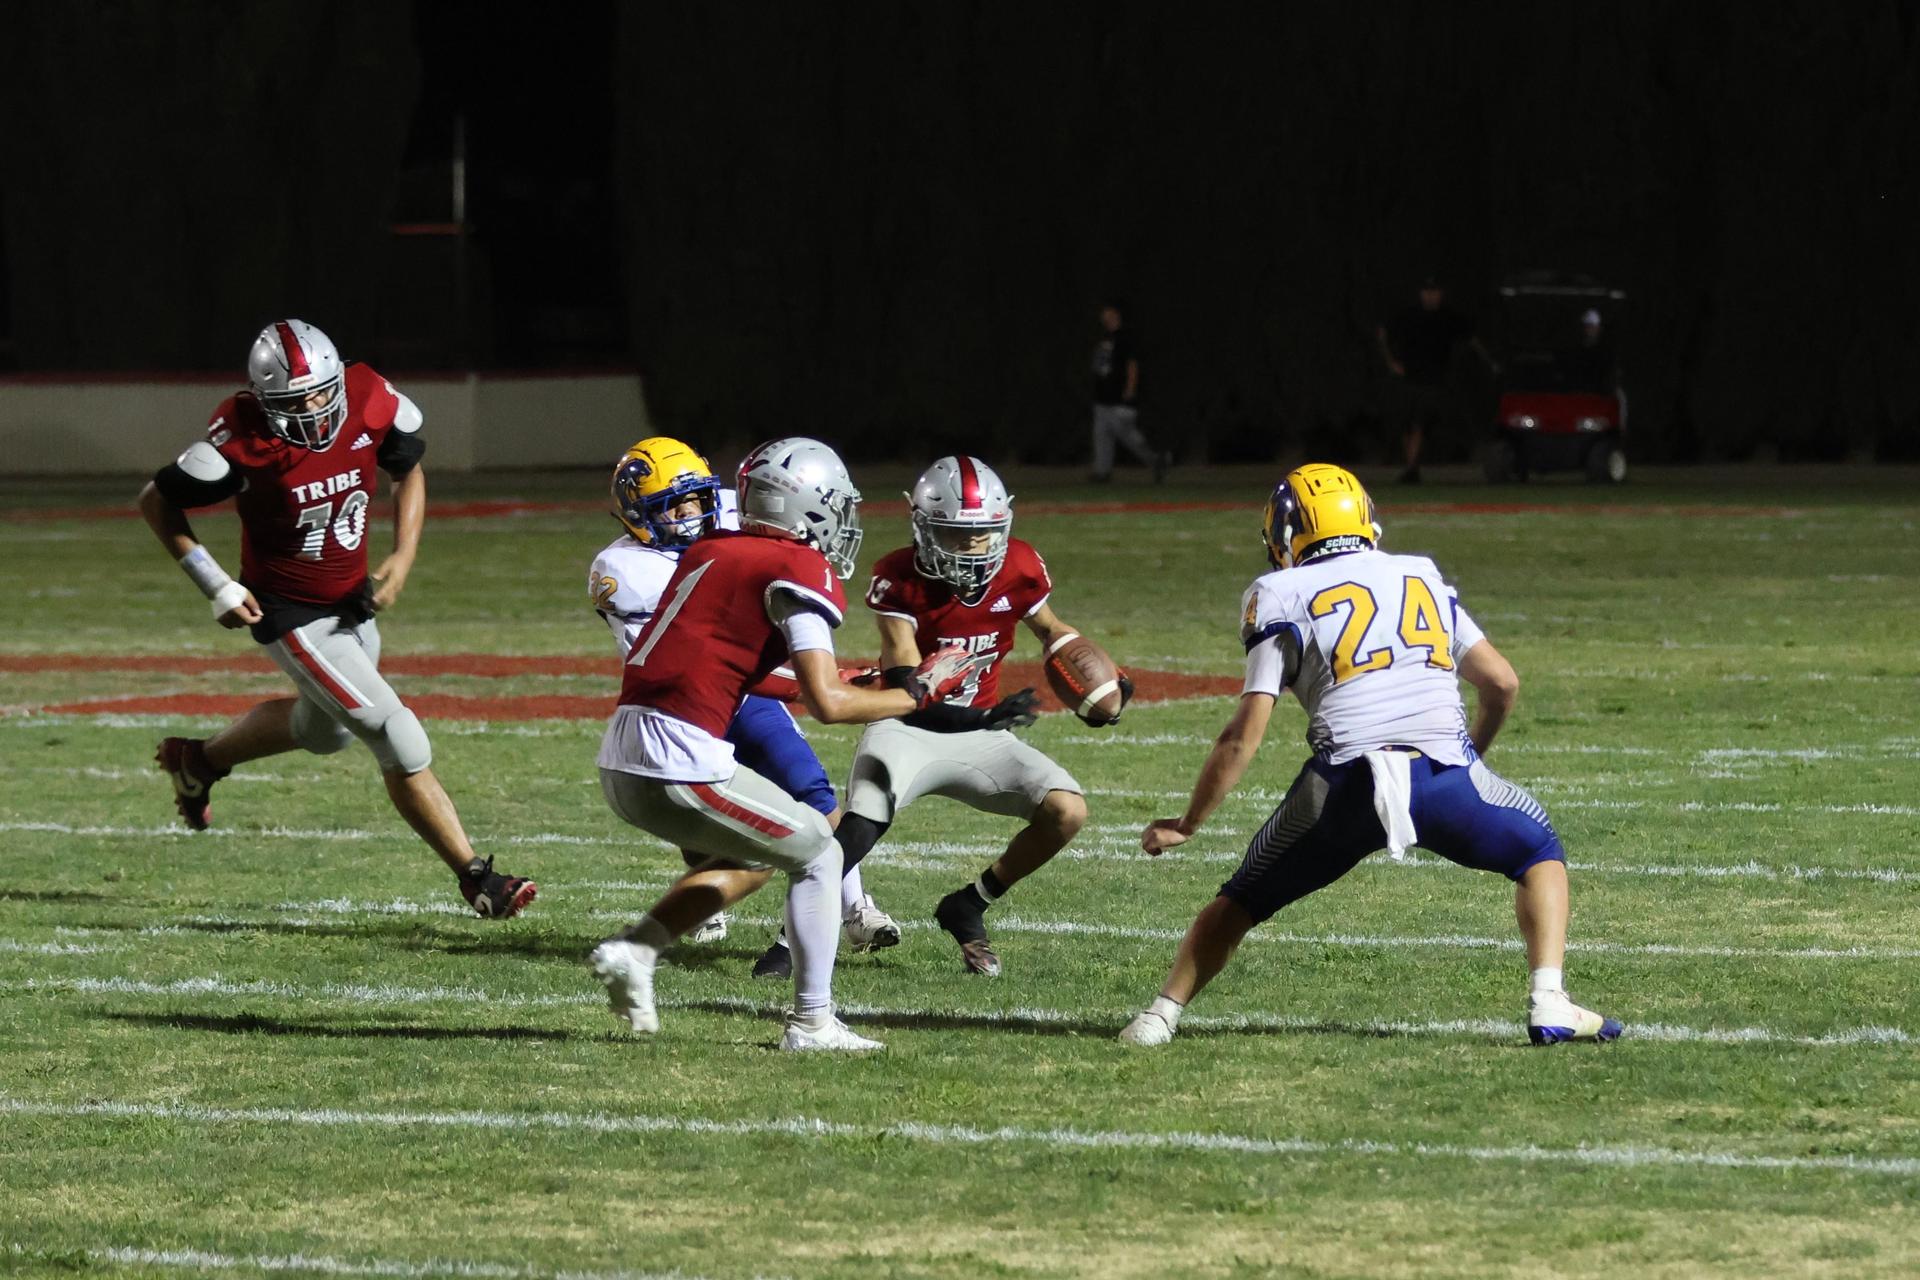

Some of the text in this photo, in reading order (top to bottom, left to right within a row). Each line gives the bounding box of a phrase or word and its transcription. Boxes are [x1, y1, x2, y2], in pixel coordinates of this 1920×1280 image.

[292, 469, 362, 504] TRIBE
[297, 490, 369, 561] 70
[1326, 536, 1360, 549] schutt
[824, 567, 834, 592] 1
[627, 559, 715, 667] 1
[1310, 576, 1454, 685] 24
[936, 632, 1000, 654] TRIBE
